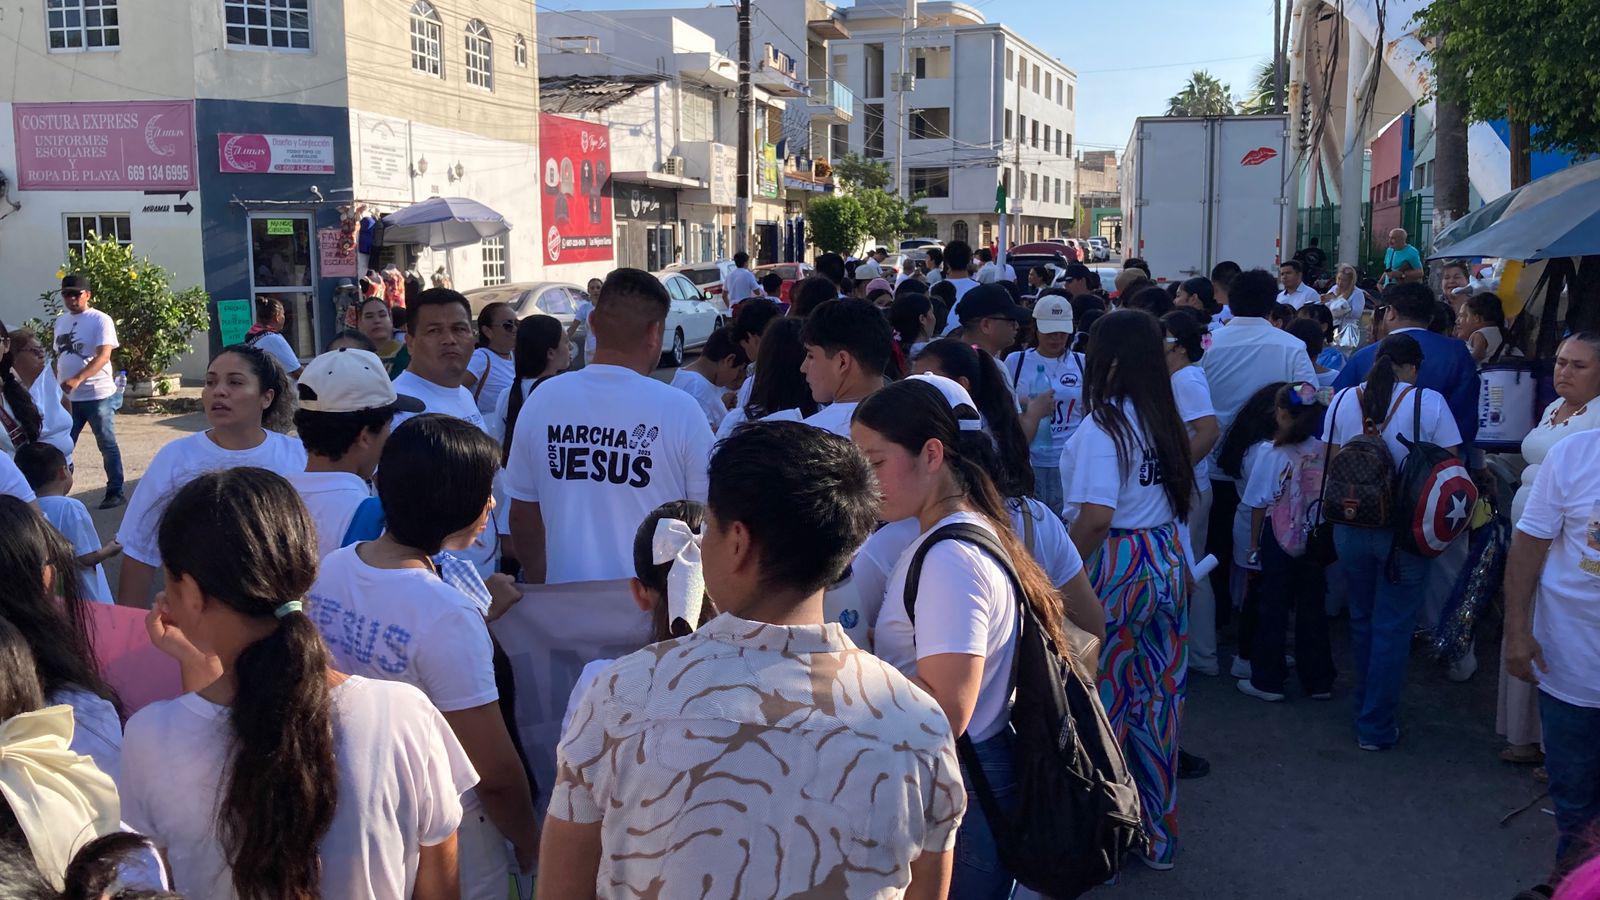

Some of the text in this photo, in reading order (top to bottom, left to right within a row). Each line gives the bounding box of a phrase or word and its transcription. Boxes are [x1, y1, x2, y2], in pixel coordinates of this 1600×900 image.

[22, 113, 139, 130] COSTURA EXPRESS
[35, 135, 109, 146] UNIFORMES
[35, 147, 107, 158] ESCOLARES
[69, 159, 77, 169] Y
[28, 170, 120, 181] ROPA DE PLAYA
[127, 165, 189, 181] 669 134 6995
[548, 424, 628, 449] MARCHA
[548, 444, 559, 468] POR
[550, 446, 653, 488] JESUS
